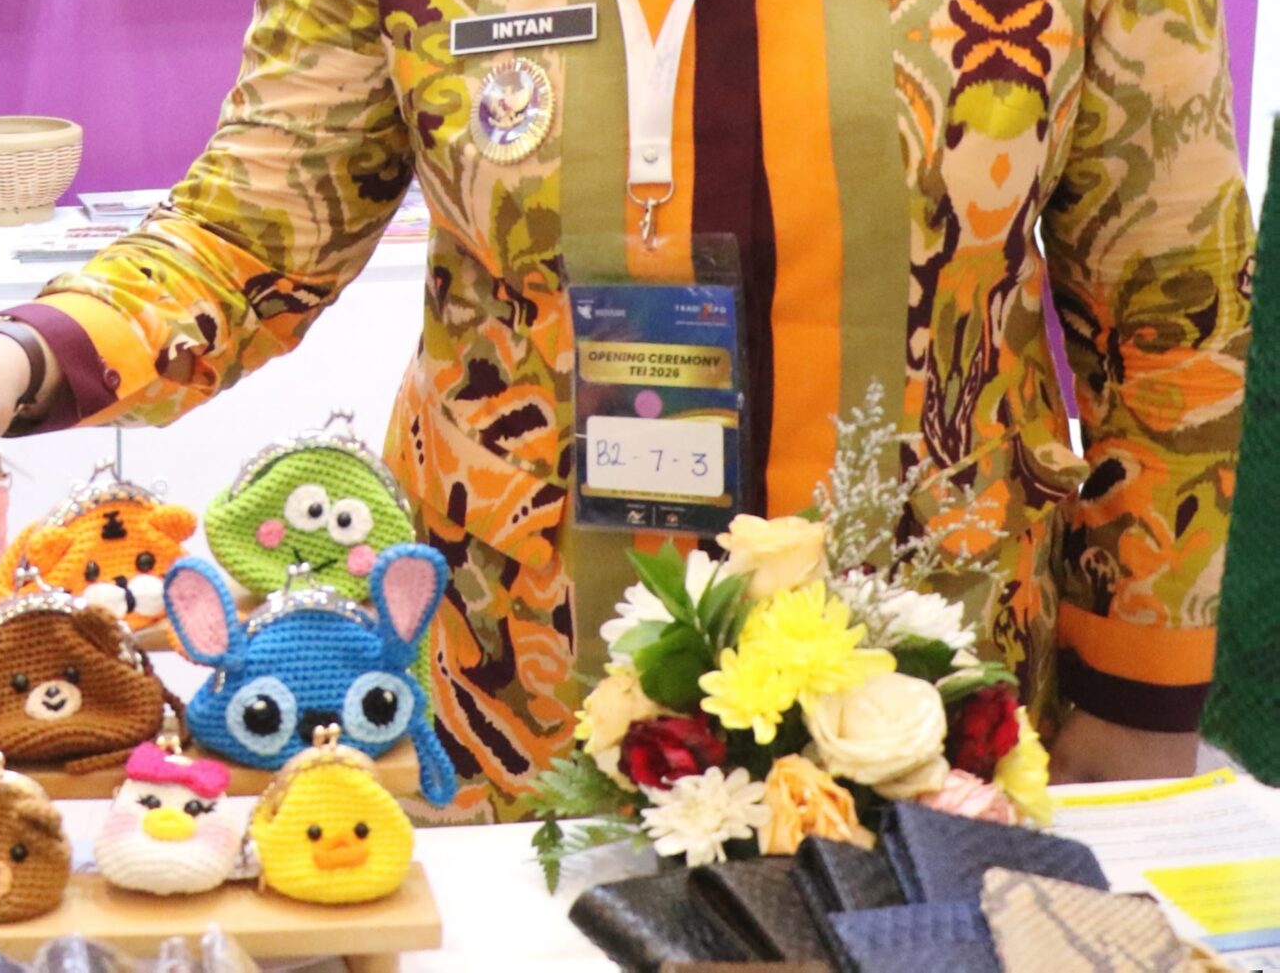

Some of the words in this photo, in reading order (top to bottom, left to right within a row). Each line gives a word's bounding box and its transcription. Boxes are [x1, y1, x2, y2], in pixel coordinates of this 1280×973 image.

[492, 16, 554, 40] INTAN
[588, 350, 646, 363] OPENING
[648, 352, 722, 367] CEREMONY
[629, 365, 647, 377] TEI
[650, 366, 680, 378] 2026
[596, 439, 626, 467] B2
